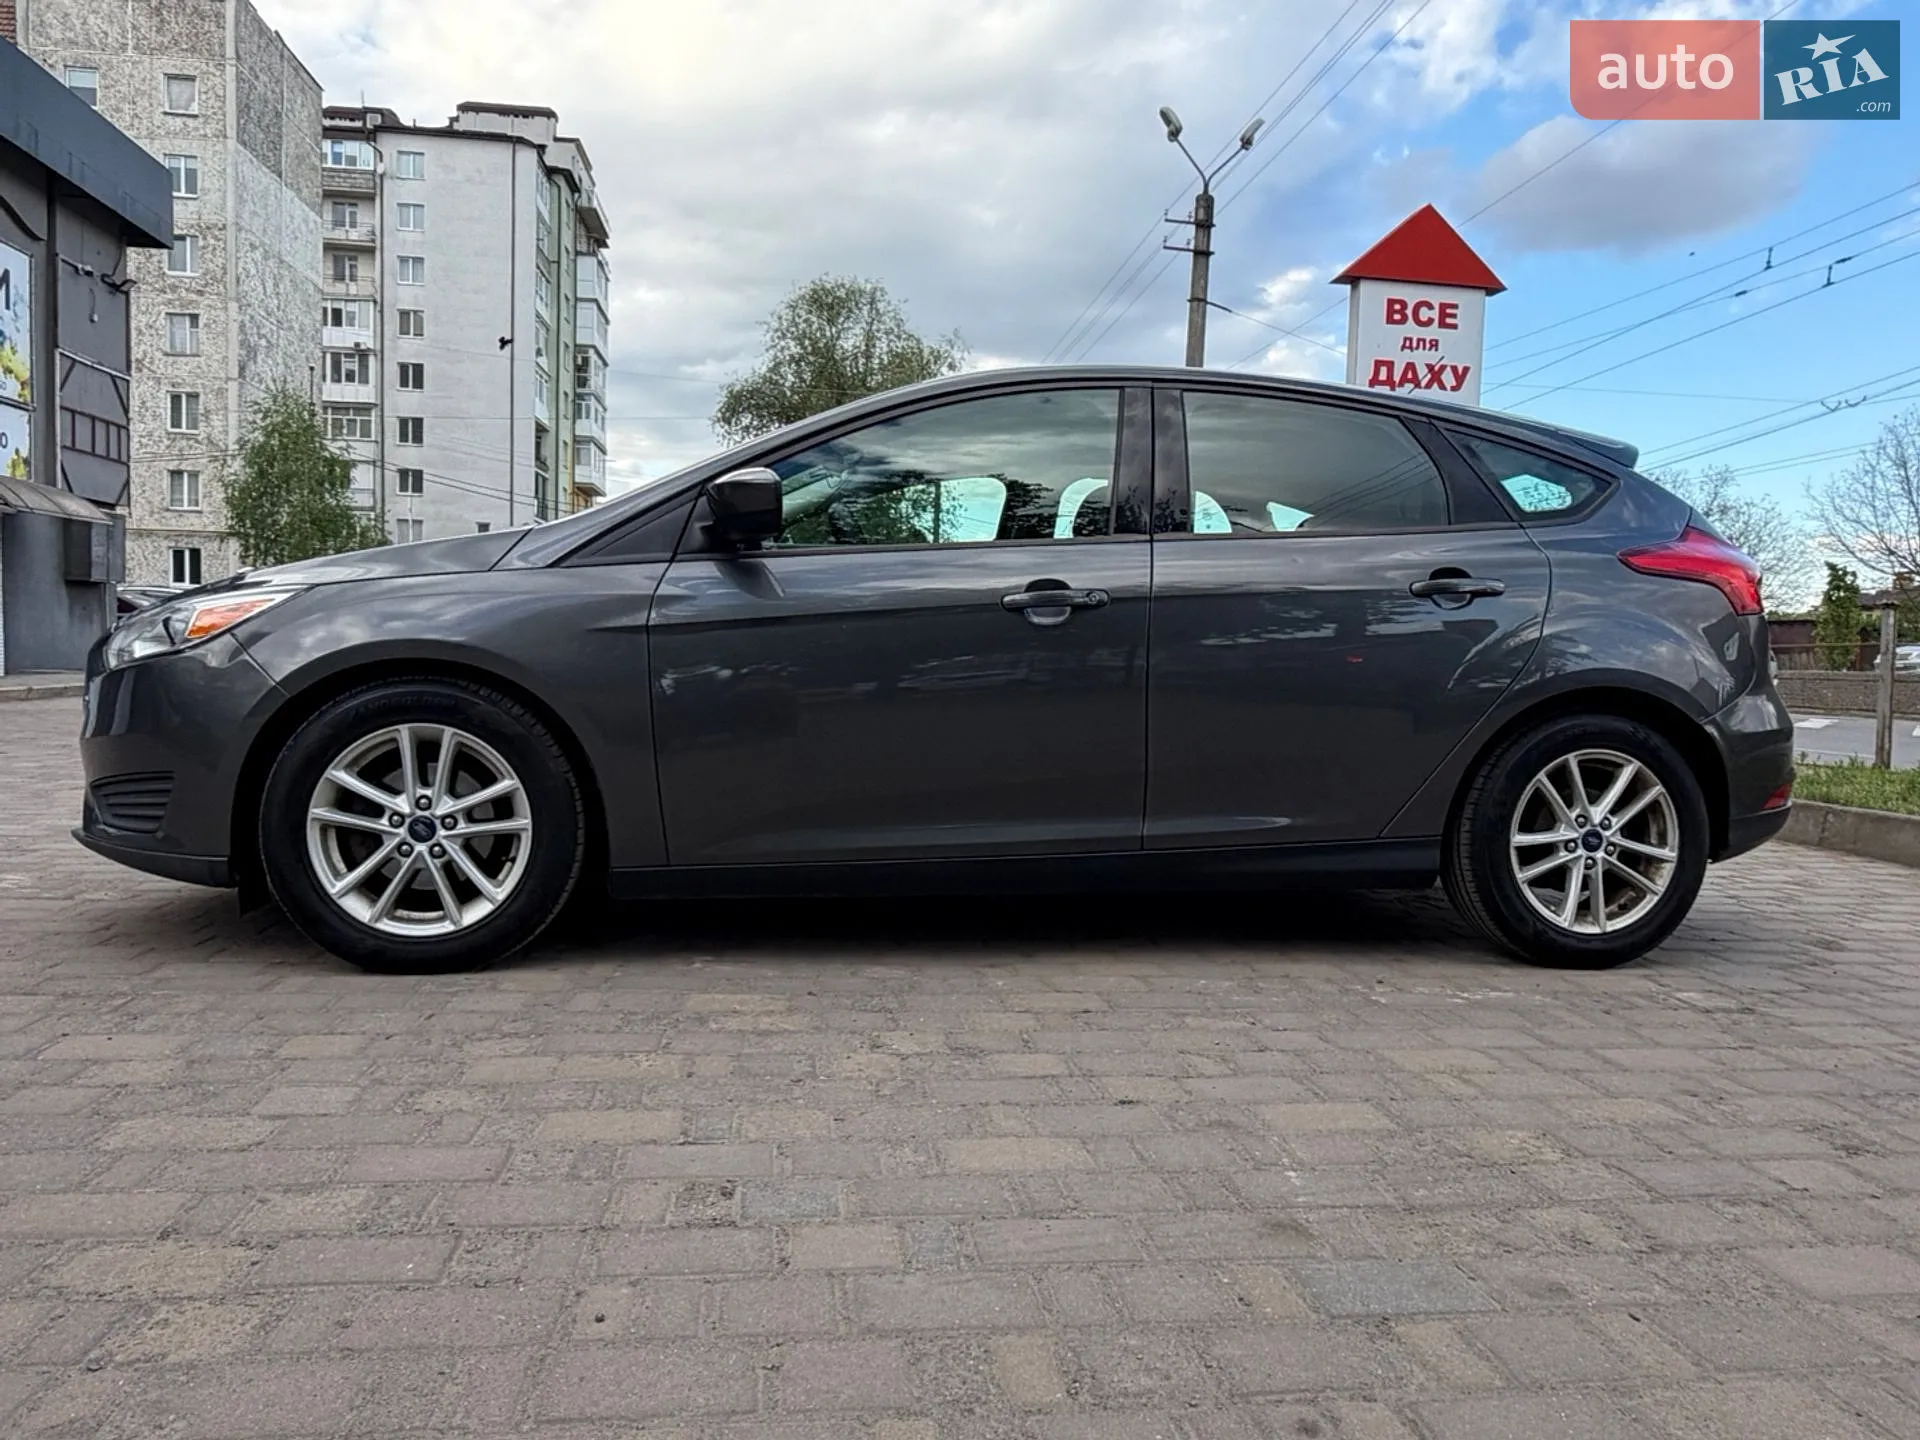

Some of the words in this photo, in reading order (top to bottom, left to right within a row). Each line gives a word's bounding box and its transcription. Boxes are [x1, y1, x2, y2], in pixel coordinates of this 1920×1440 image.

[1385, 297, 1459, 330] ВСЕ
[1400, 336, 1440, 352] для
[1367, 358, 1471, 392] ДАХУ
